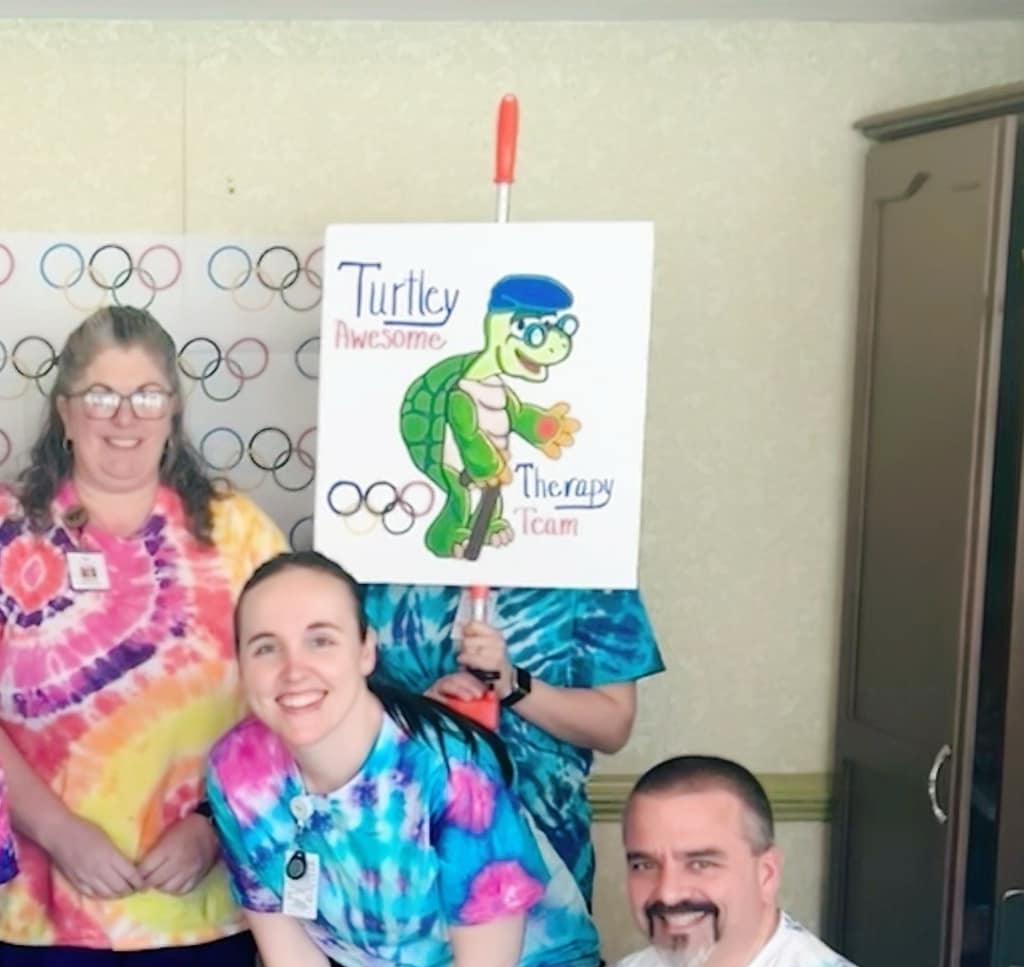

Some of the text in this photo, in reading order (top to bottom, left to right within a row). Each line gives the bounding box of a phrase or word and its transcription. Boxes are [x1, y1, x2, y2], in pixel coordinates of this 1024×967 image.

[337, 261, 460, 327] Turtley
[334, 319, 448, 351] Awesome
[514, 463, 615, 510] Therapy
[513, 507, 579, 536] Team
